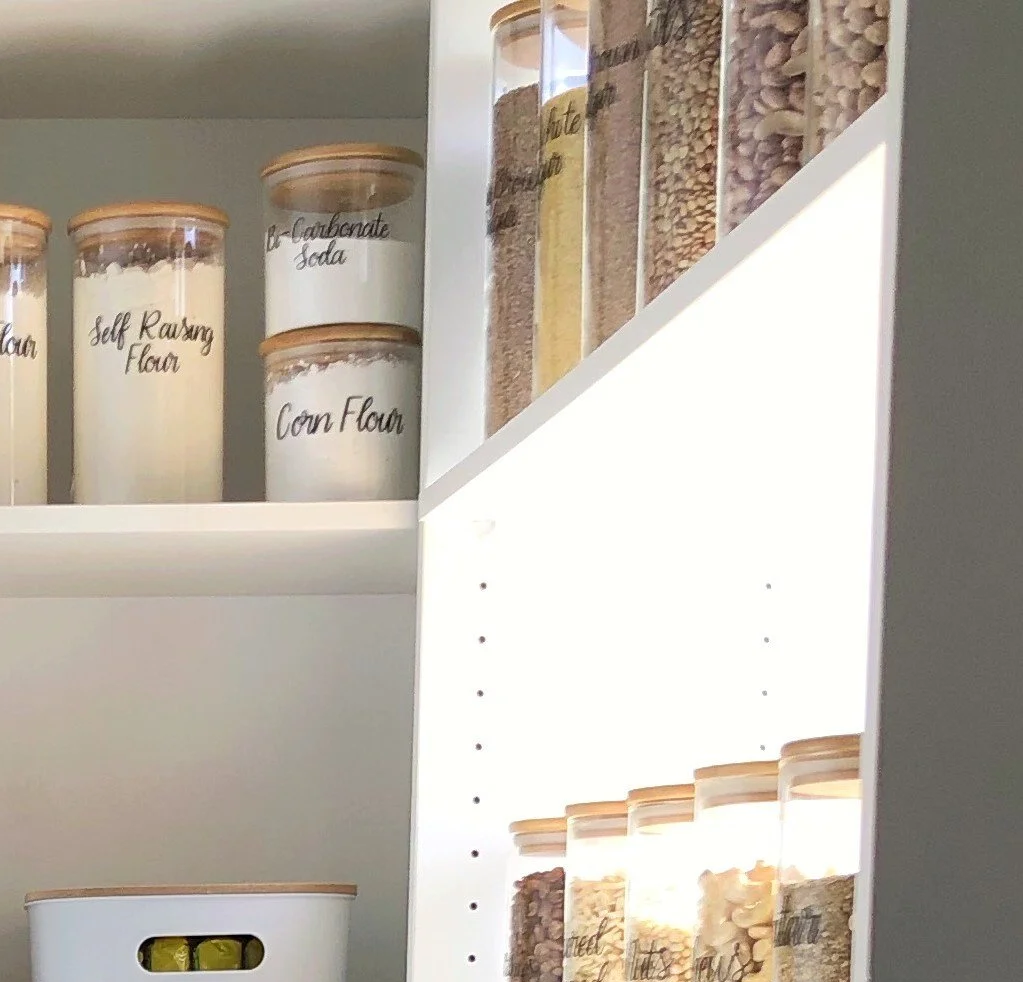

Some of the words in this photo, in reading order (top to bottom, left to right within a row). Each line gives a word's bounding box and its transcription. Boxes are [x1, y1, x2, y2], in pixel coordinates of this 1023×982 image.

[293, 239, 347, 271] Soda
[88, 311, 132, 351] Self
[138, 309, 214, 357] Raising
[124, 342, 181, 375] Flour
[276, 402, 334, 441] Corn
[339, 395, 404, 435] Flour
